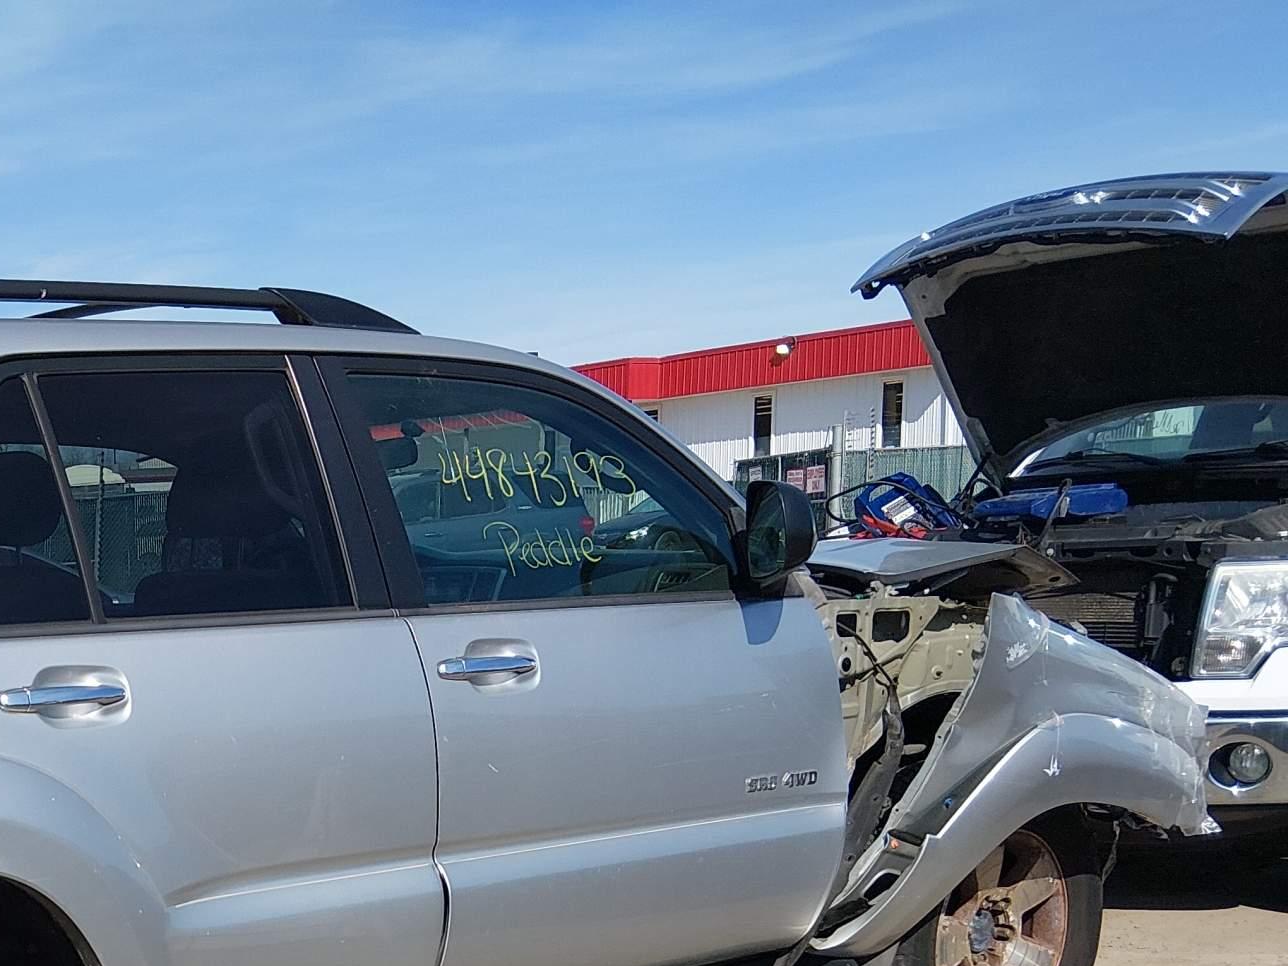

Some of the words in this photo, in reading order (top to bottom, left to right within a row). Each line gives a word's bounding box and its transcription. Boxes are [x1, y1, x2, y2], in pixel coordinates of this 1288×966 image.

[438, 447, 636, 506] 44843193
[482, 521, 603, 577] Peddle
[782, 770, 818, 789] 4WD
